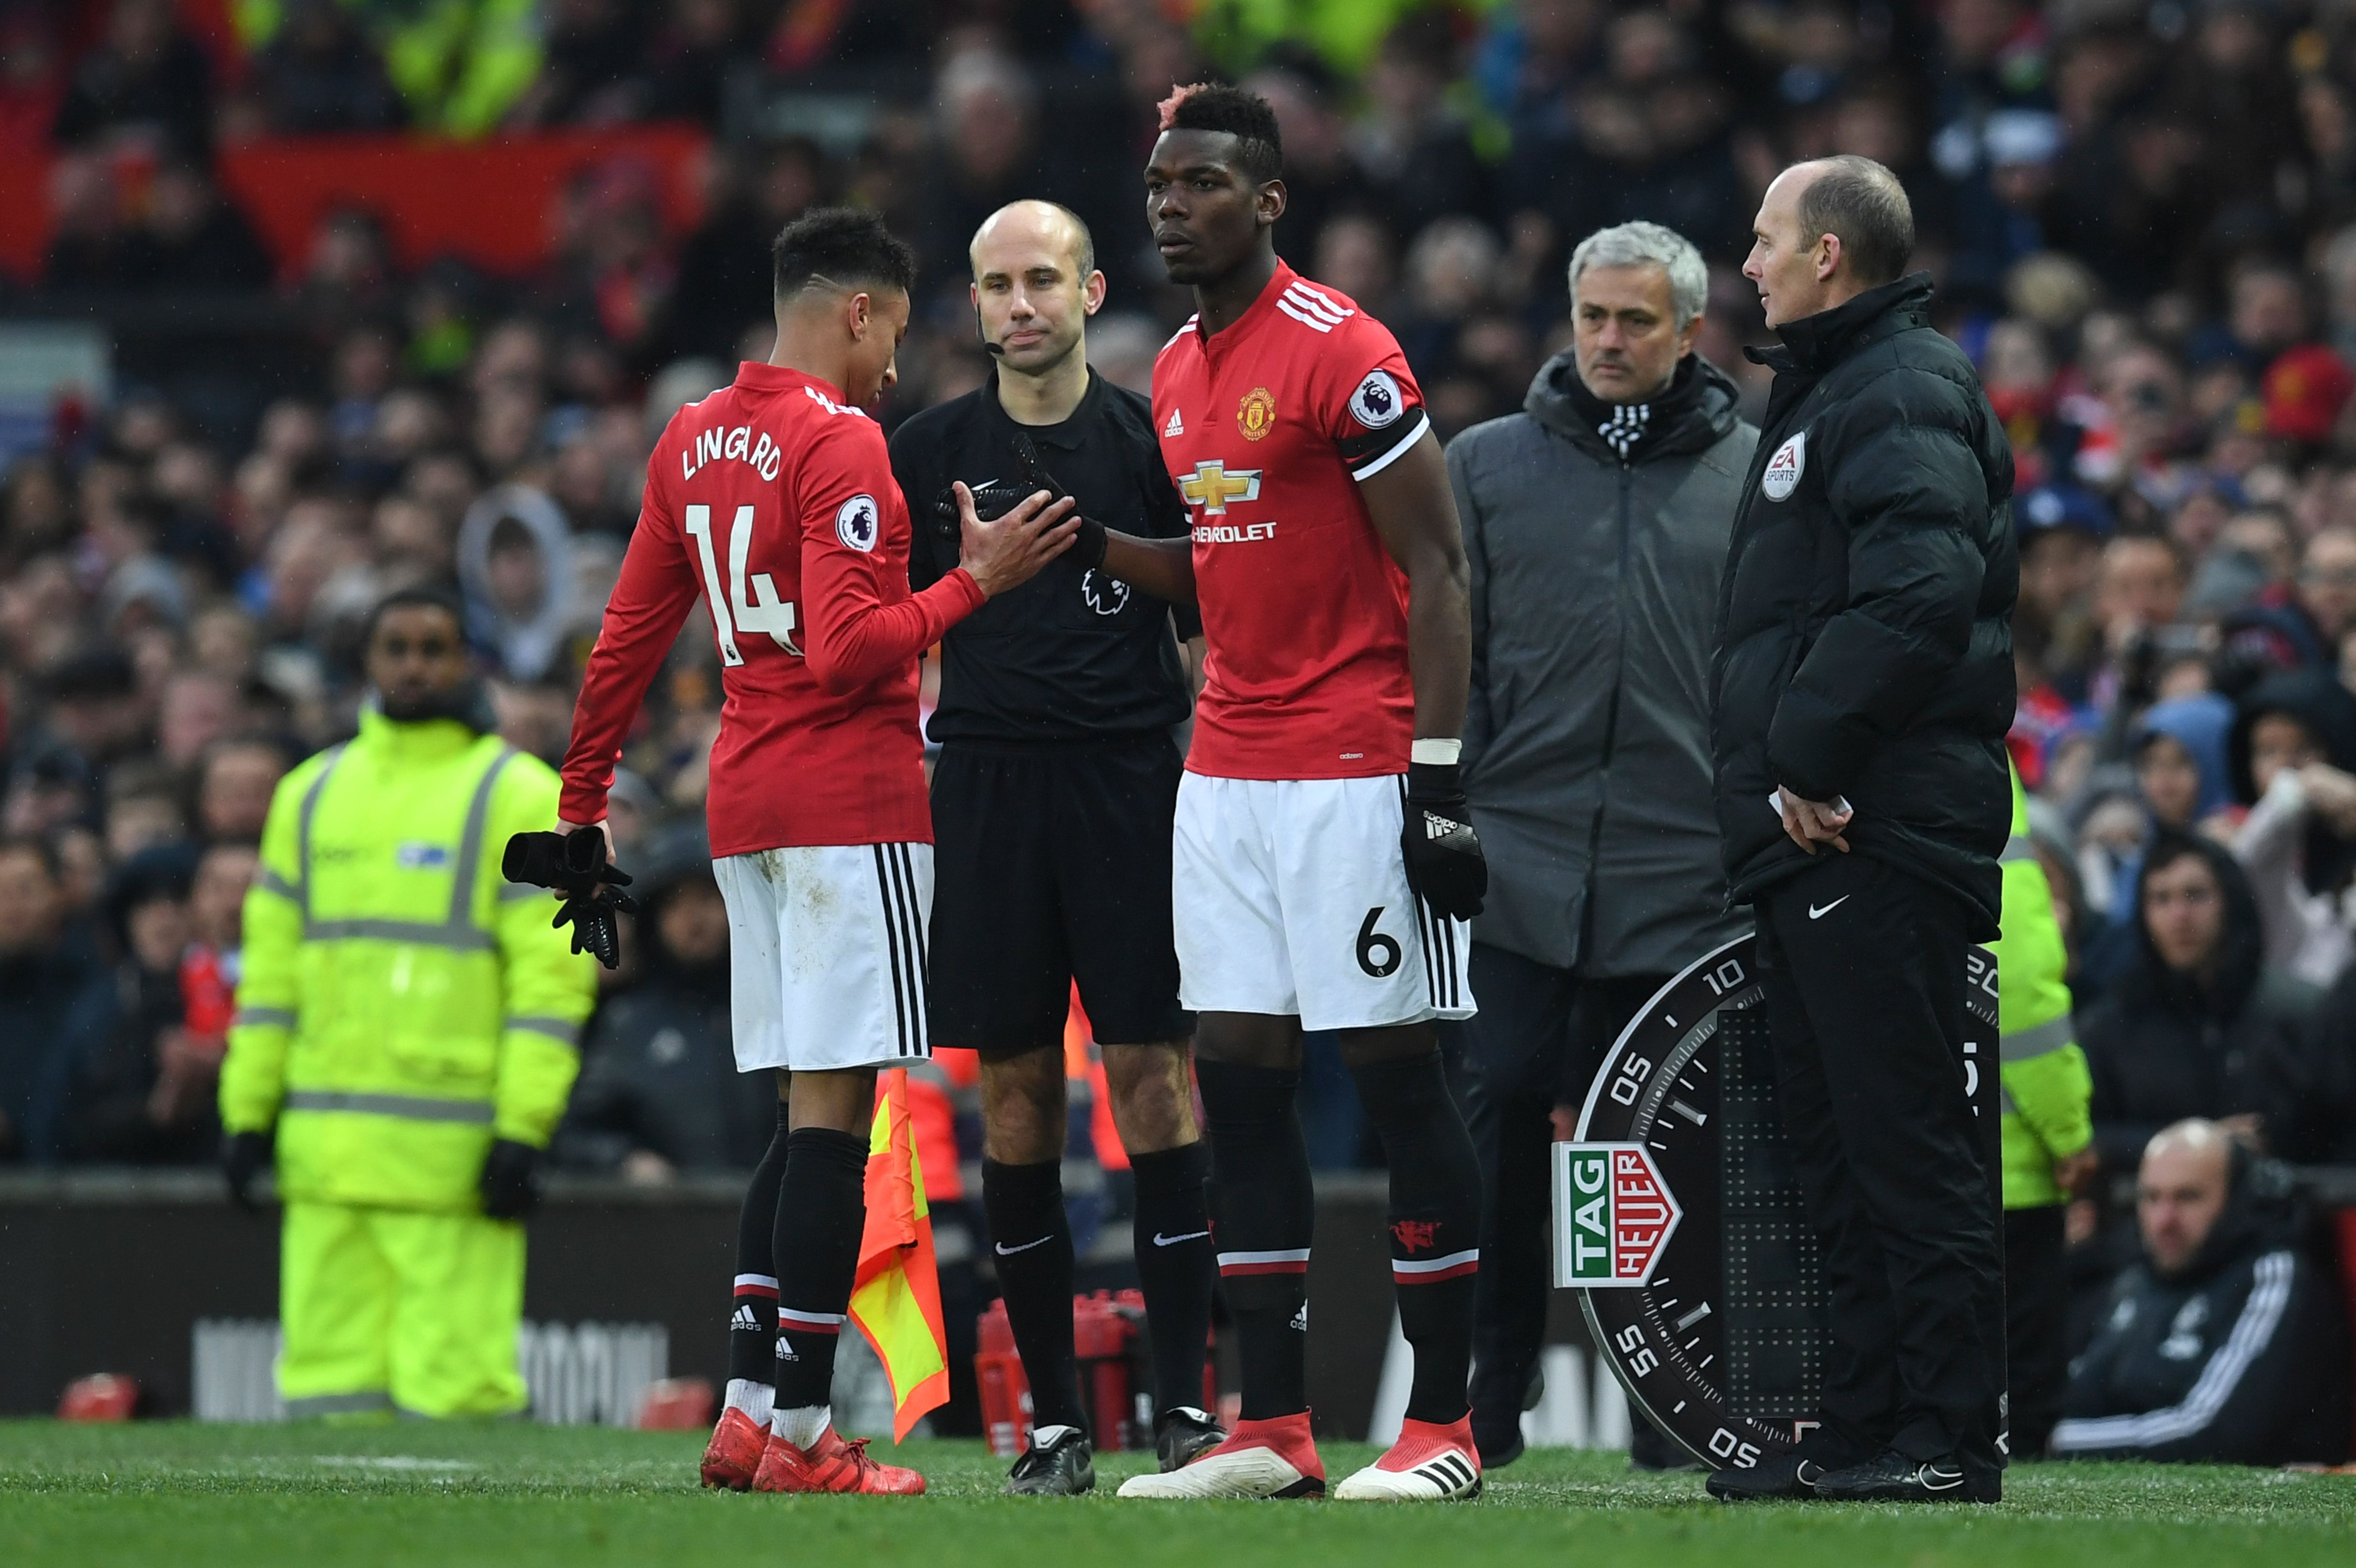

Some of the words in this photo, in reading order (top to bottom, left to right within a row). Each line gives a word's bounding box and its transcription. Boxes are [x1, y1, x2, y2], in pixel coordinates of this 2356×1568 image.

[683, 425, 781, 481] LINGARD
[1243, 428, 1266, 437] UNITED
[1766, 470, 1794, 481] SPORTS
[1771, 445, 1795, 468] EA
[1192, 522, 1277, 543] HEVROLET
[686, 505, 805, 666] 14
[1423, 810, 1458, 829] adidas
[1356, 906, 1402, 978] 6
[1702, 959, 1745, 996] 10
[1610, 1051, 1651, 1106] 05
[1574, 1159, 1607, 1271] TAG
[1617, 1155, 1669, 1273] HEUER
[1615, 1325, 1660, 1378] 55
[1708, 1427, 1762, 1469] 50
